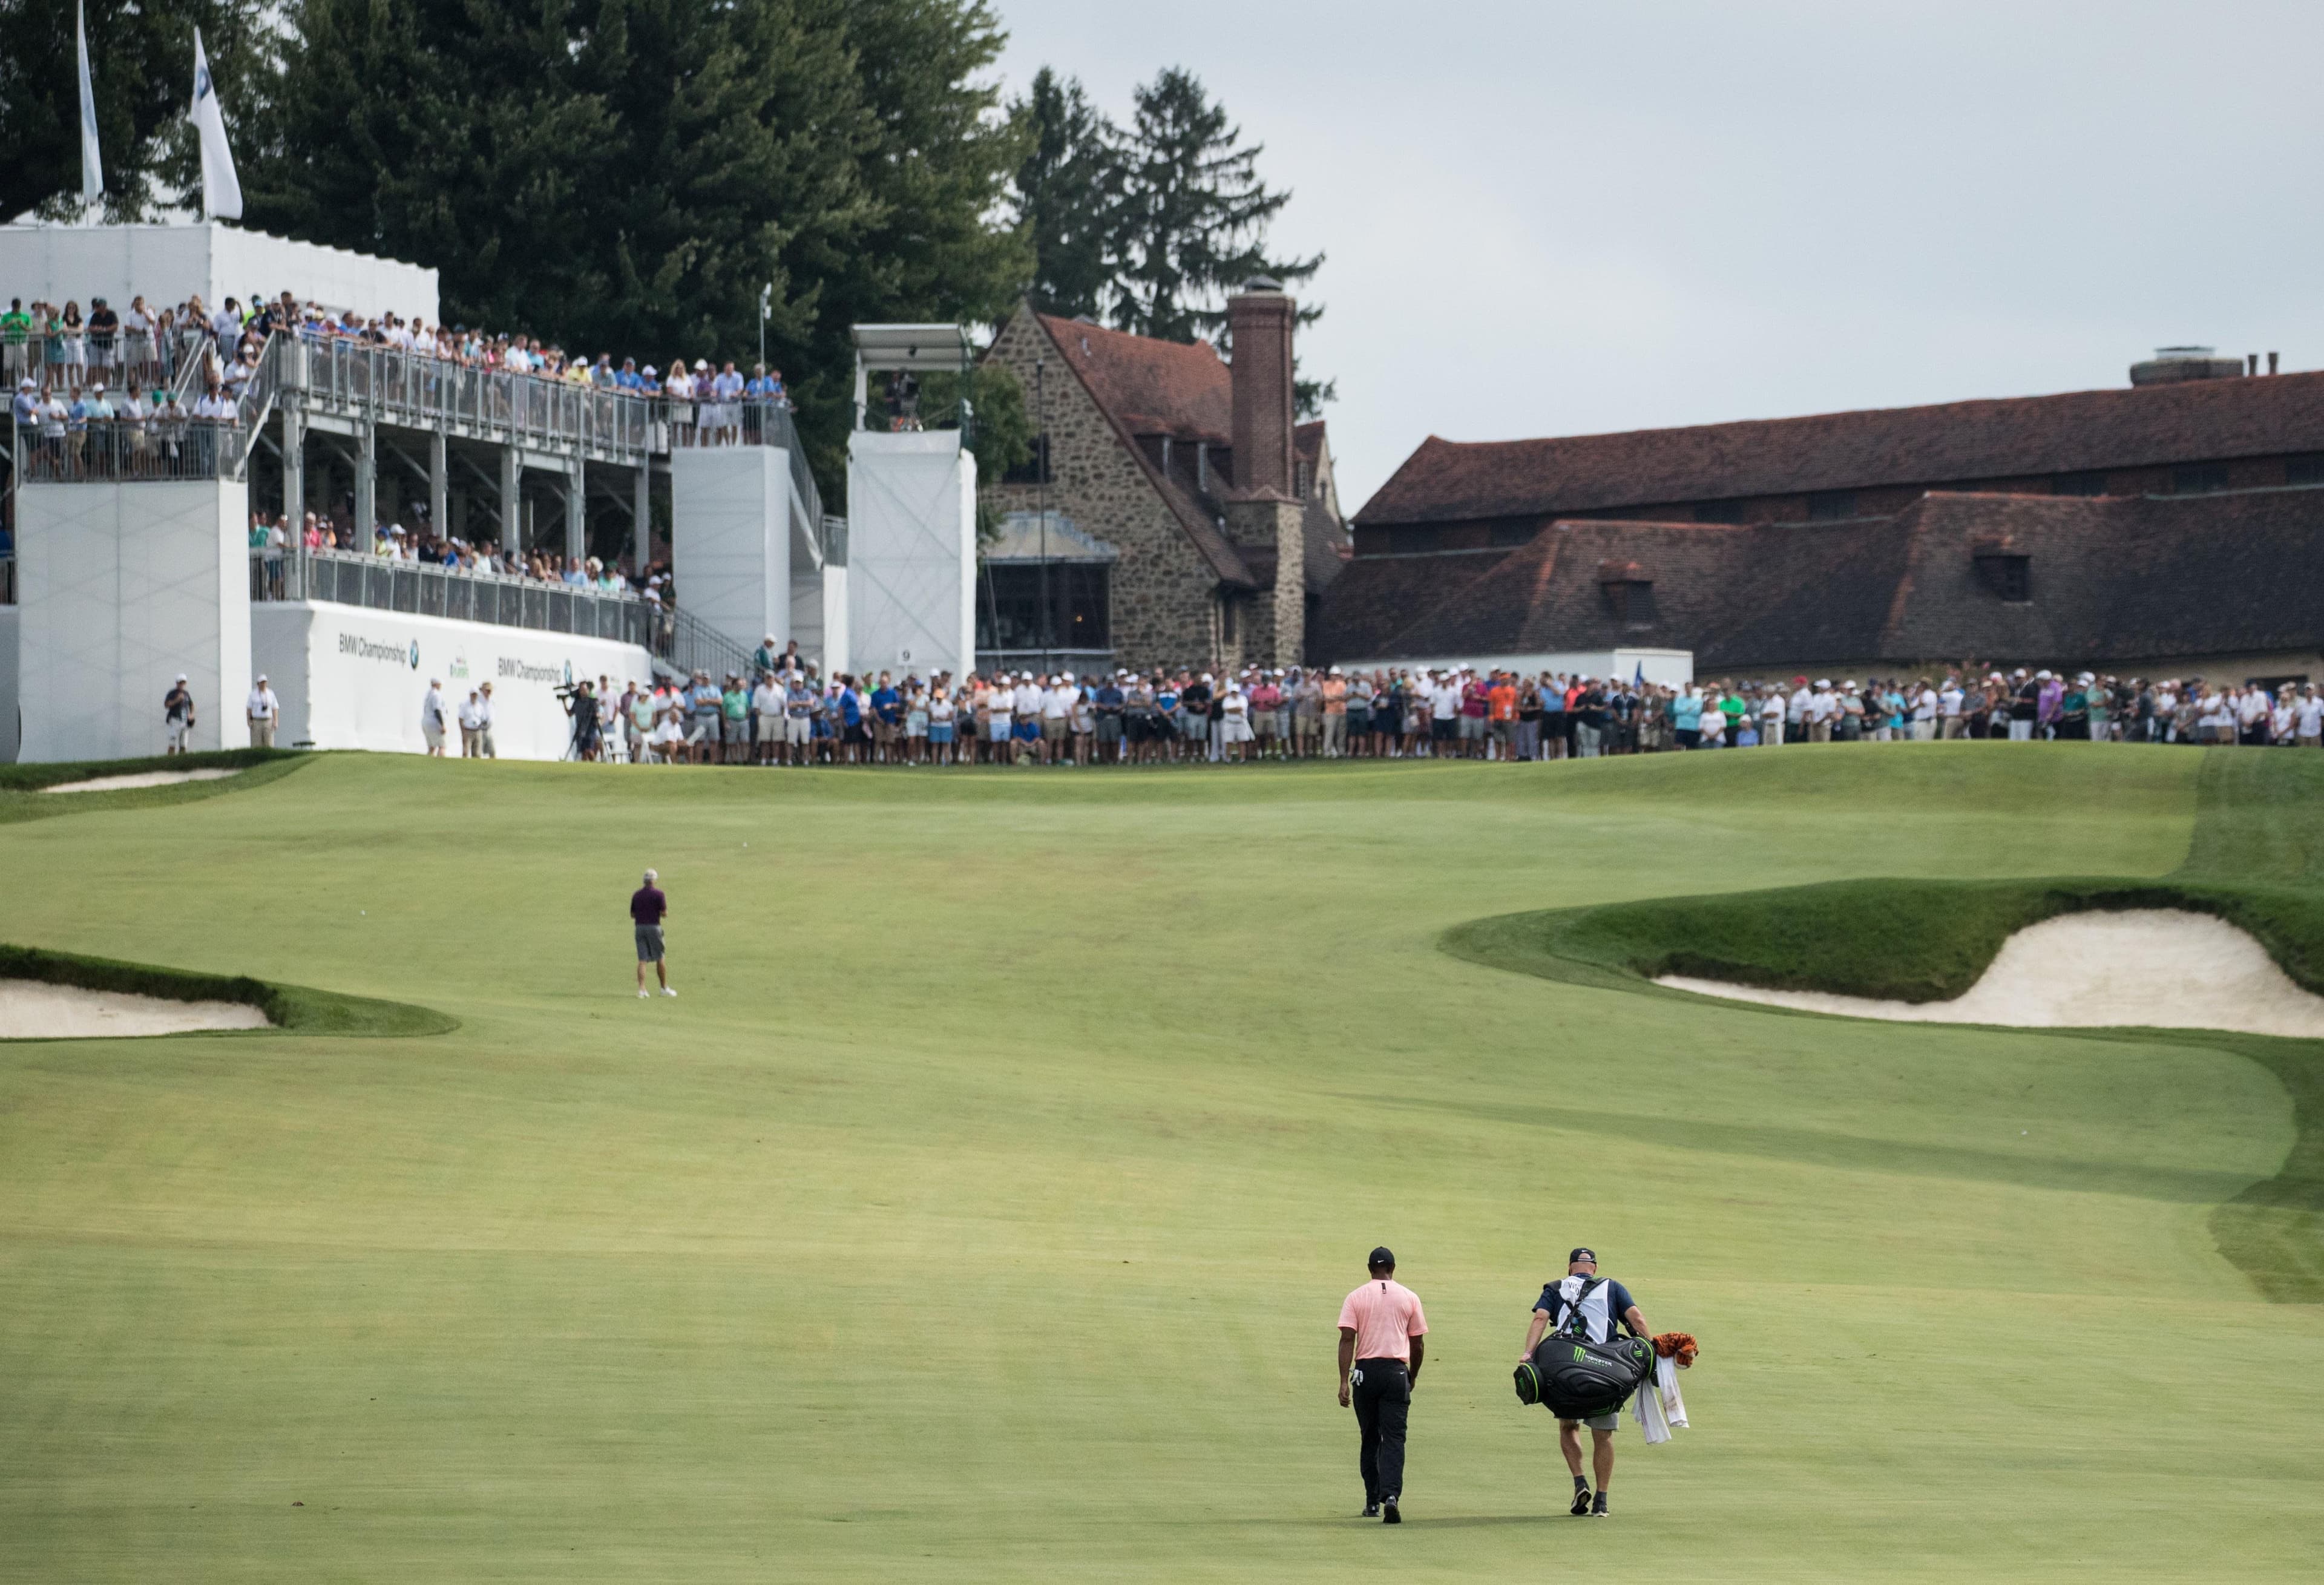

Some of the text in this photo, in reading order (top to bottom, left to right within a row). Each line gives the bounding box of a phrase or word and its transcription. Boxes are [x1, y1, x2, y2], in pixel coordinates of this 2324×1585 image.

[340, 634, 406, 668] BMW Championship
[903, 649, 910, 661] 9
[499, 658, 561, 687] BMW Championship
[1585, 1354, 1612, 1367] MONSTER
